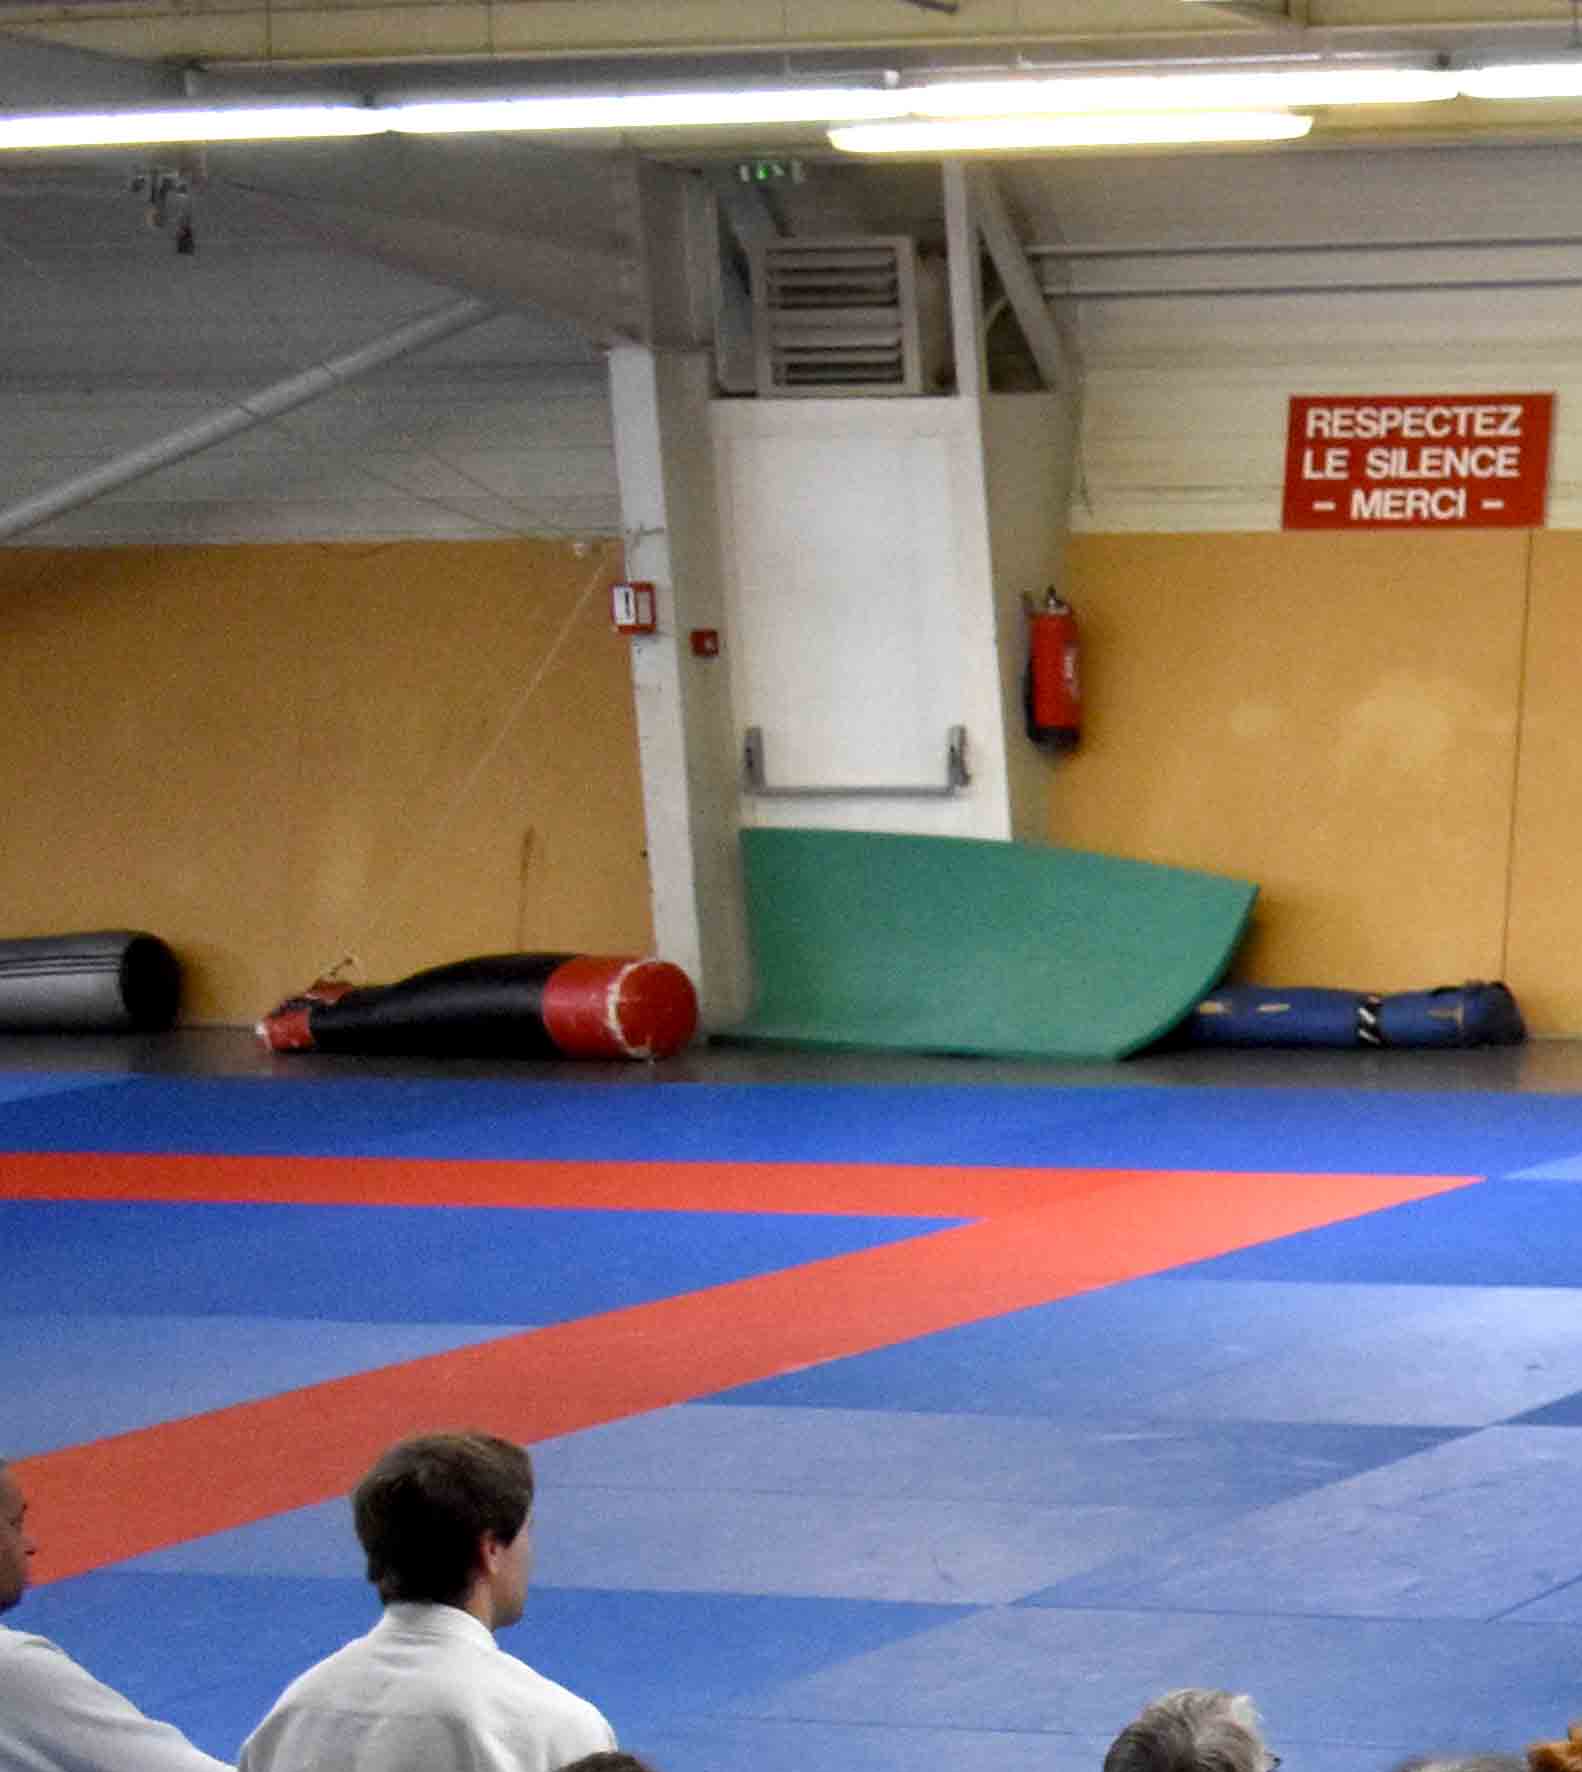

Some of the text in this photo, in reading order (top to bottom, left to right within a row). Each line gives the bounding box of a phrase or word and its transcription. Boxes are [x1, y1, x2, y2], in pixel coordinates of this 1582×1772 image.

[1306, 404, 1522, 439] RESPECTEZ
[1303, 446, 1522, 481] LE SILENCE
[1350, 487, 1468, 522] MERCI
